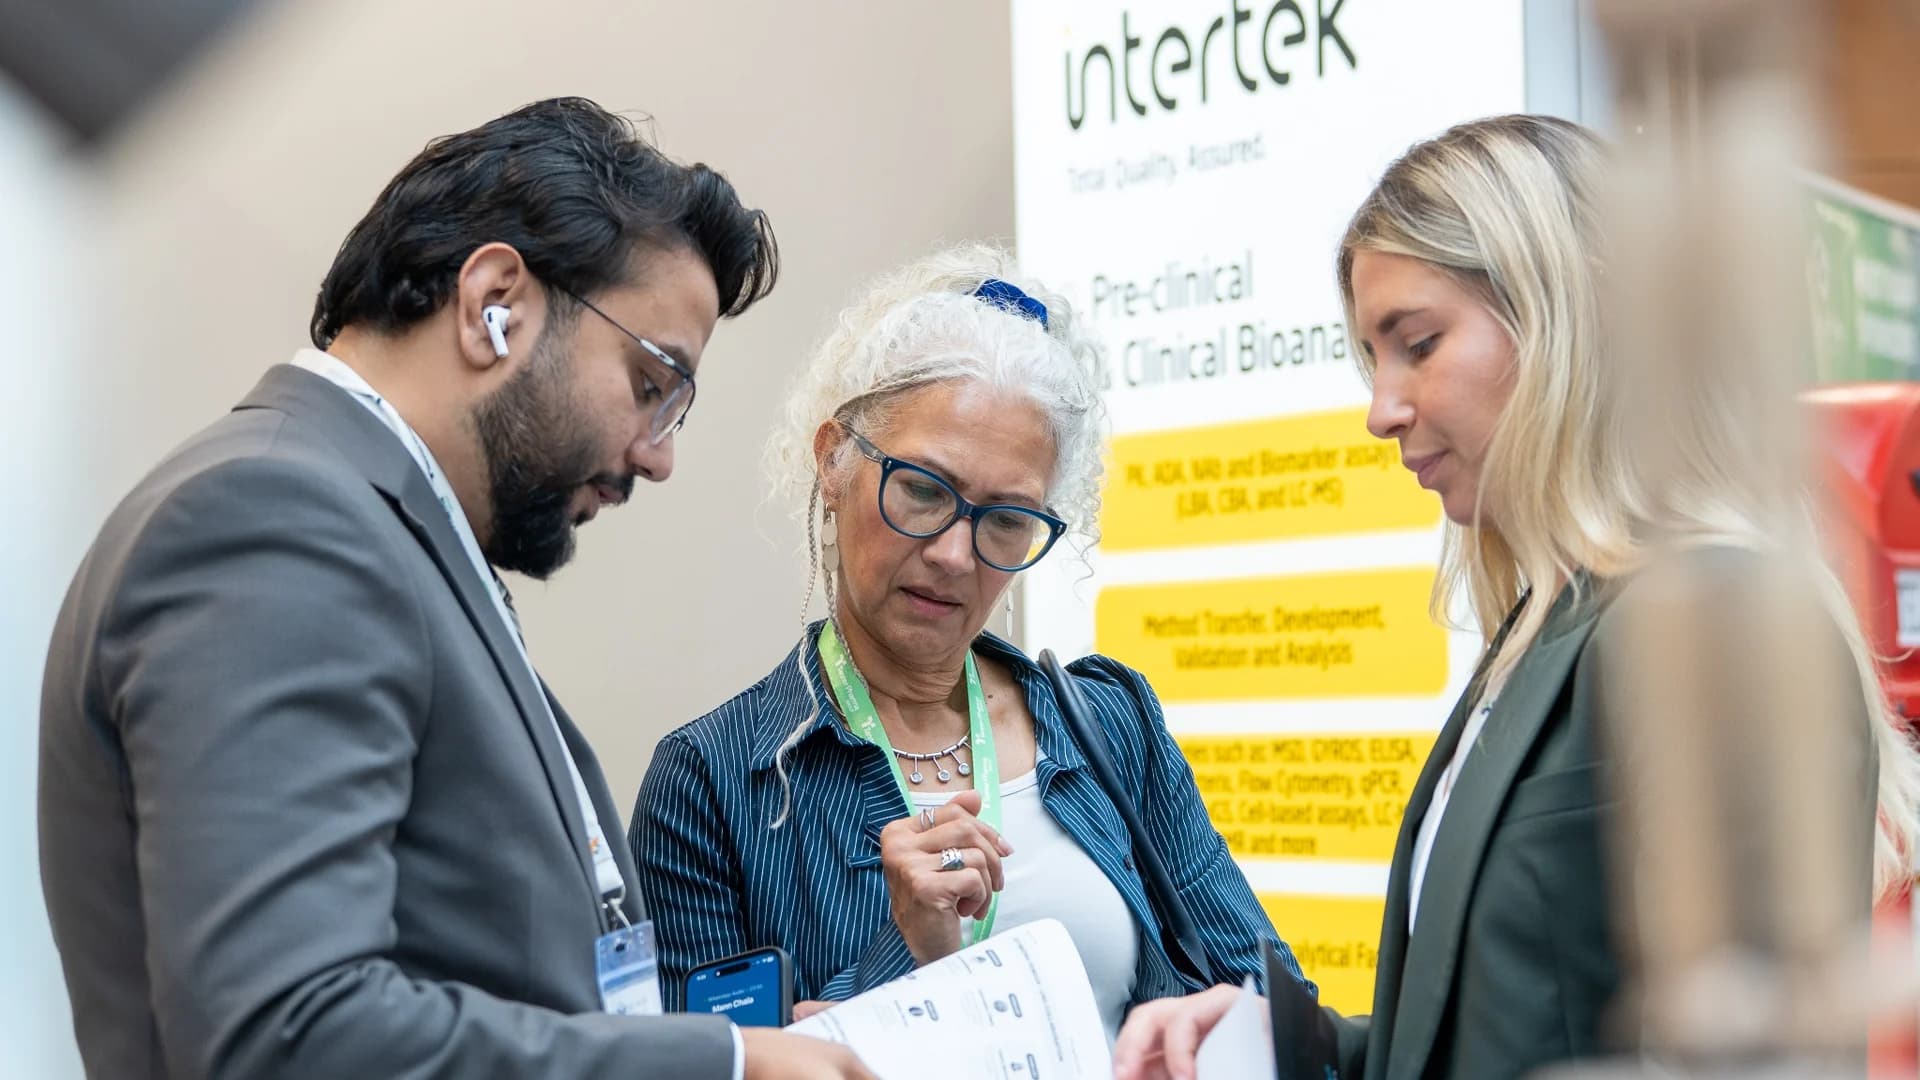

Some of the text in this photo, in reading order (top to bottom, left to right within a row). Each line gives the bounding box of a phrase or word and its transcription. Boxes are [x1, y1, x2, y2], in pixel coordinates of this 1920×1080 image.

[1063, 0, 1357, 130] intertek
[1067, 167, 1105, 192] Total
[1093, 249, 1252, 318] Pre-clinical
[1125, 326, 1226, 387] Clinical
[1239, 319, 1348, 372] Bioana
[1228, 456, 1254, 477] and
[1261, 448, 1339, 476] Biomarker
[1258, 486, 1285, 510] and
[1144, 614, 1198, 637] Method
[1174, 641, 1352, 671] Validation and Analysis
[1213, 741, 1243, 763] such
[1249, 744, 1266, 762] as
[1239, 769, 1272, 793] Flow
[1239, 800, 1312, 824] Cell-based
[1251, 832, 1276, 854] and
[1281, 837, 1317, 854] more
[1293, 939, 1351, 973] alytical
